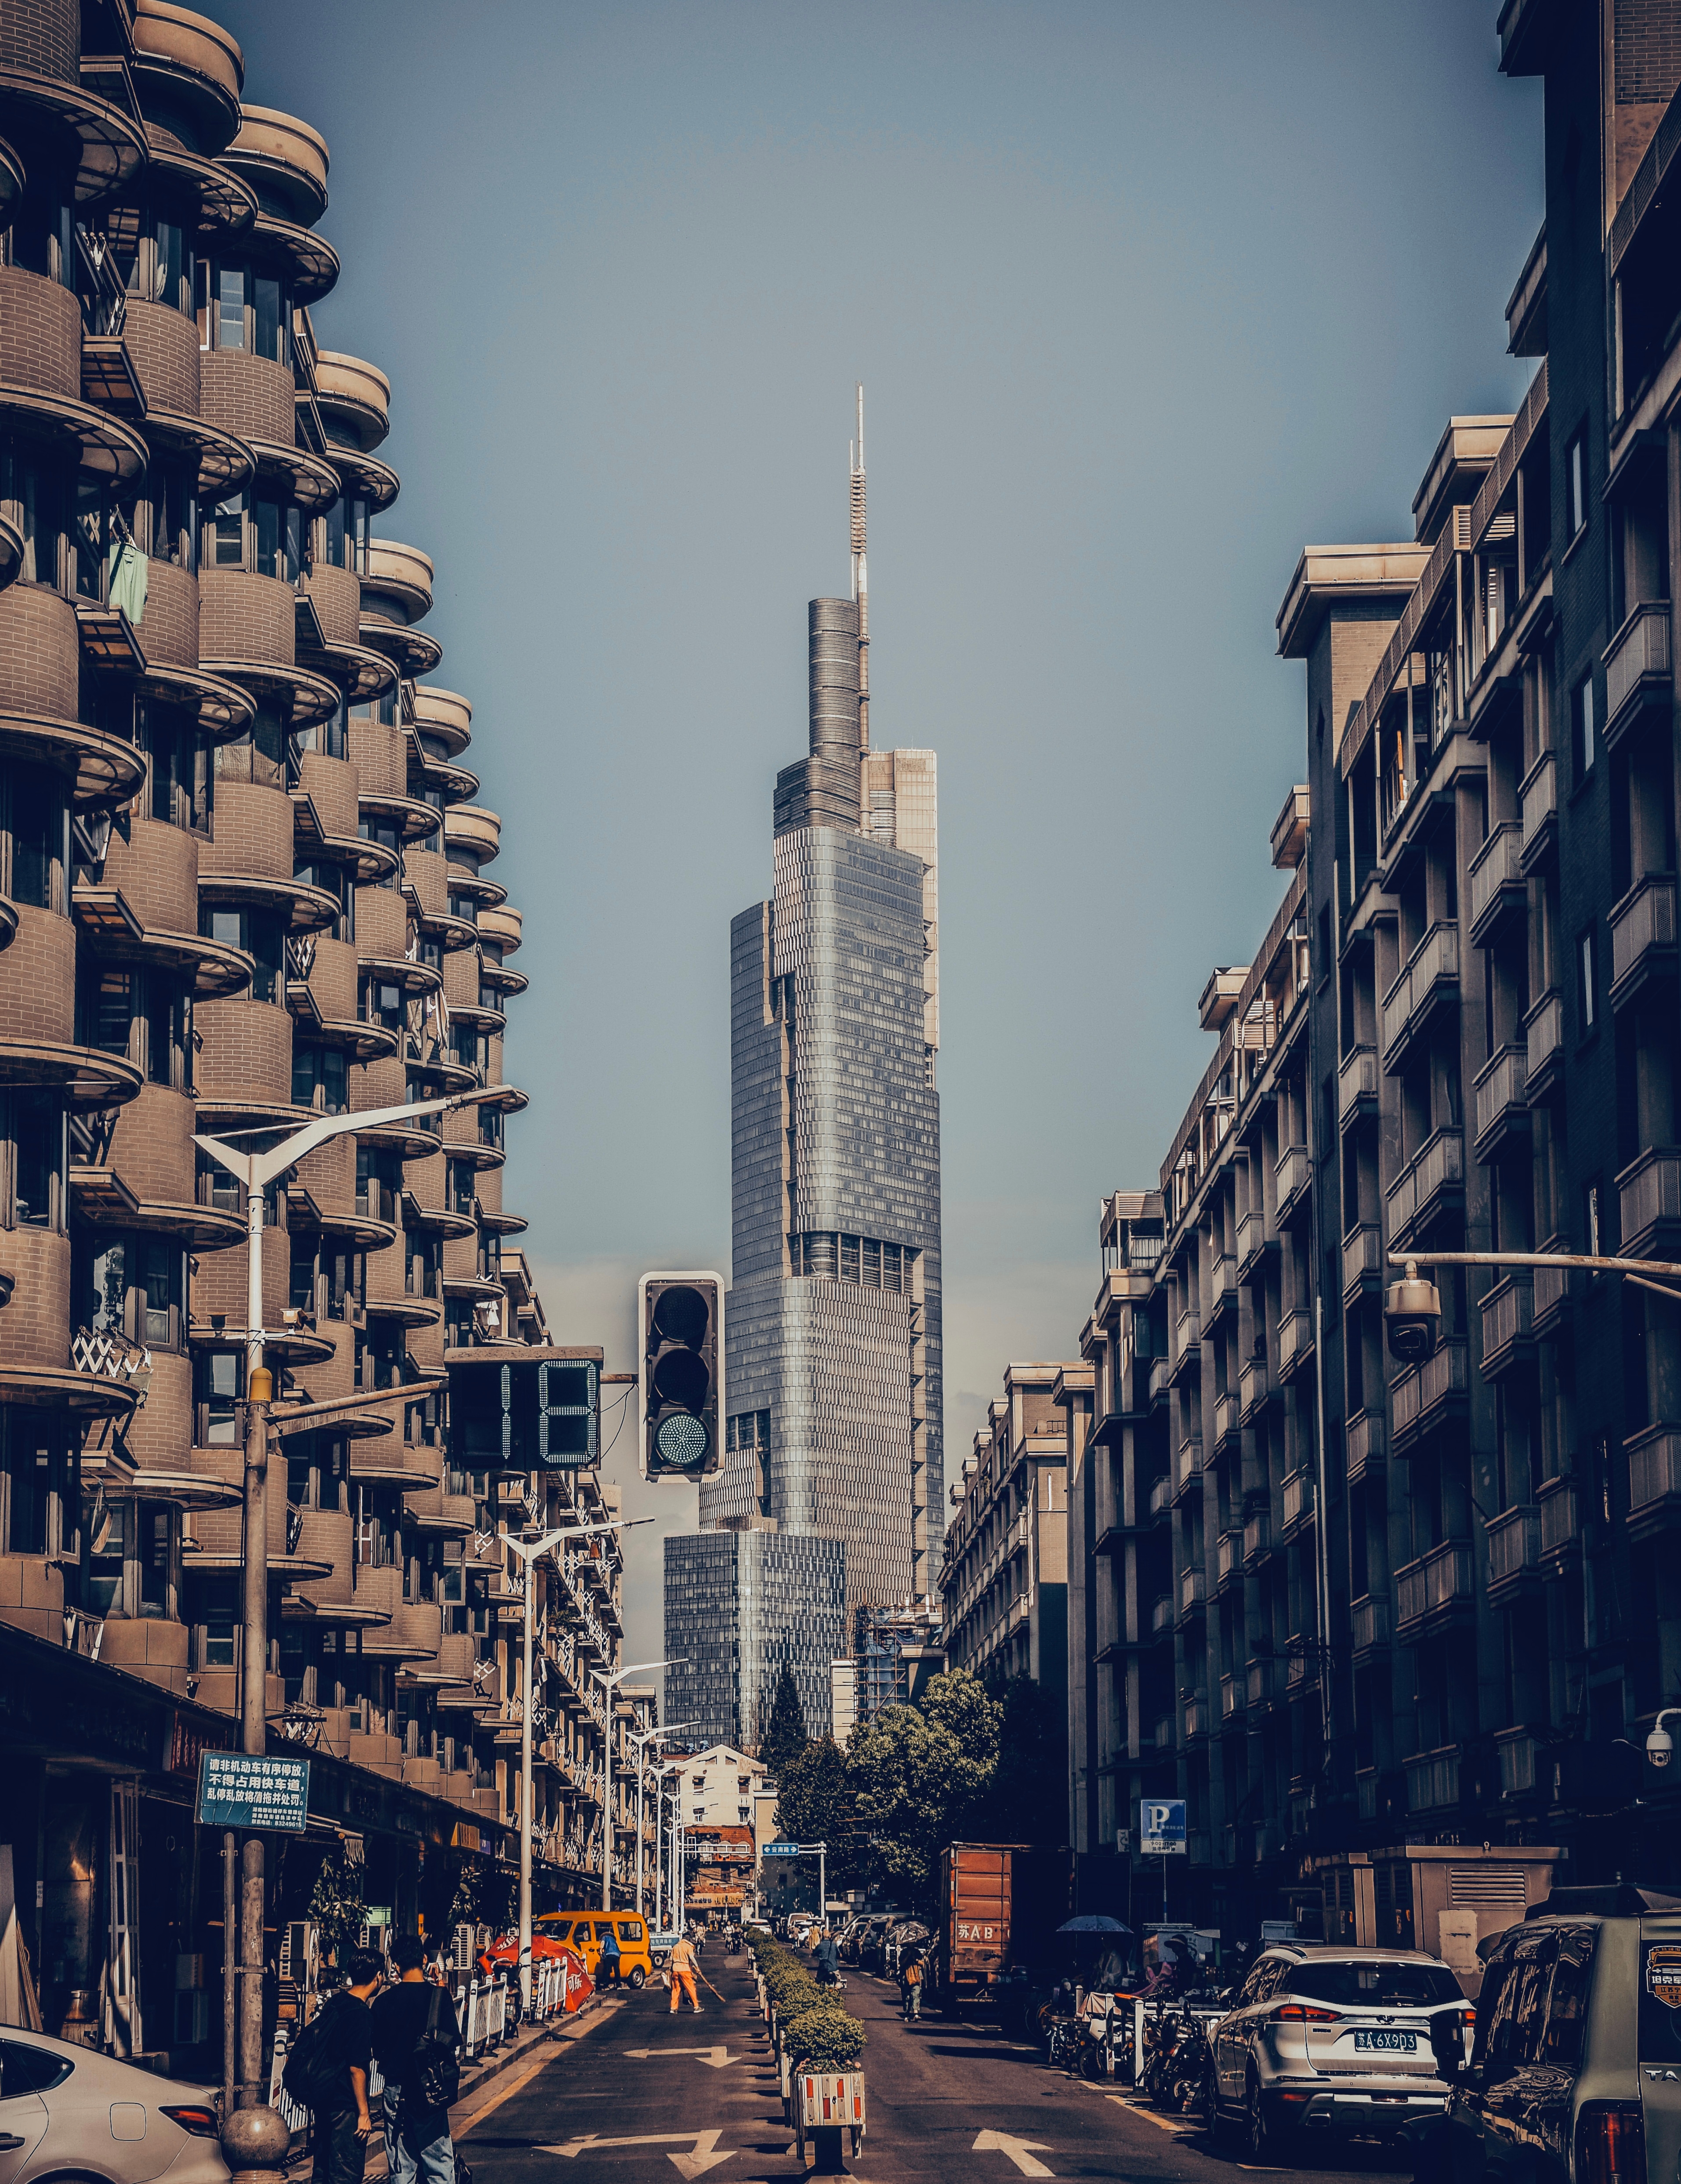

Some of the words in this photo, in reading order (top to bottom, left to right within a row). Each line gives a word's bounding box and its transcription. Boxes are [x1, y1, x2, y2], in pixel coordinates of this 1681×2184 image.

[501, 1360, 597, 1463] 18
[210, 1759, 304, 1777] 请非机动车有序停放，
[209, 1773, 304, 1792] 不得占用快车道，
[1148, 1806, 1170, 1833] P
[1644, 2070, 1679, 2082] TA
